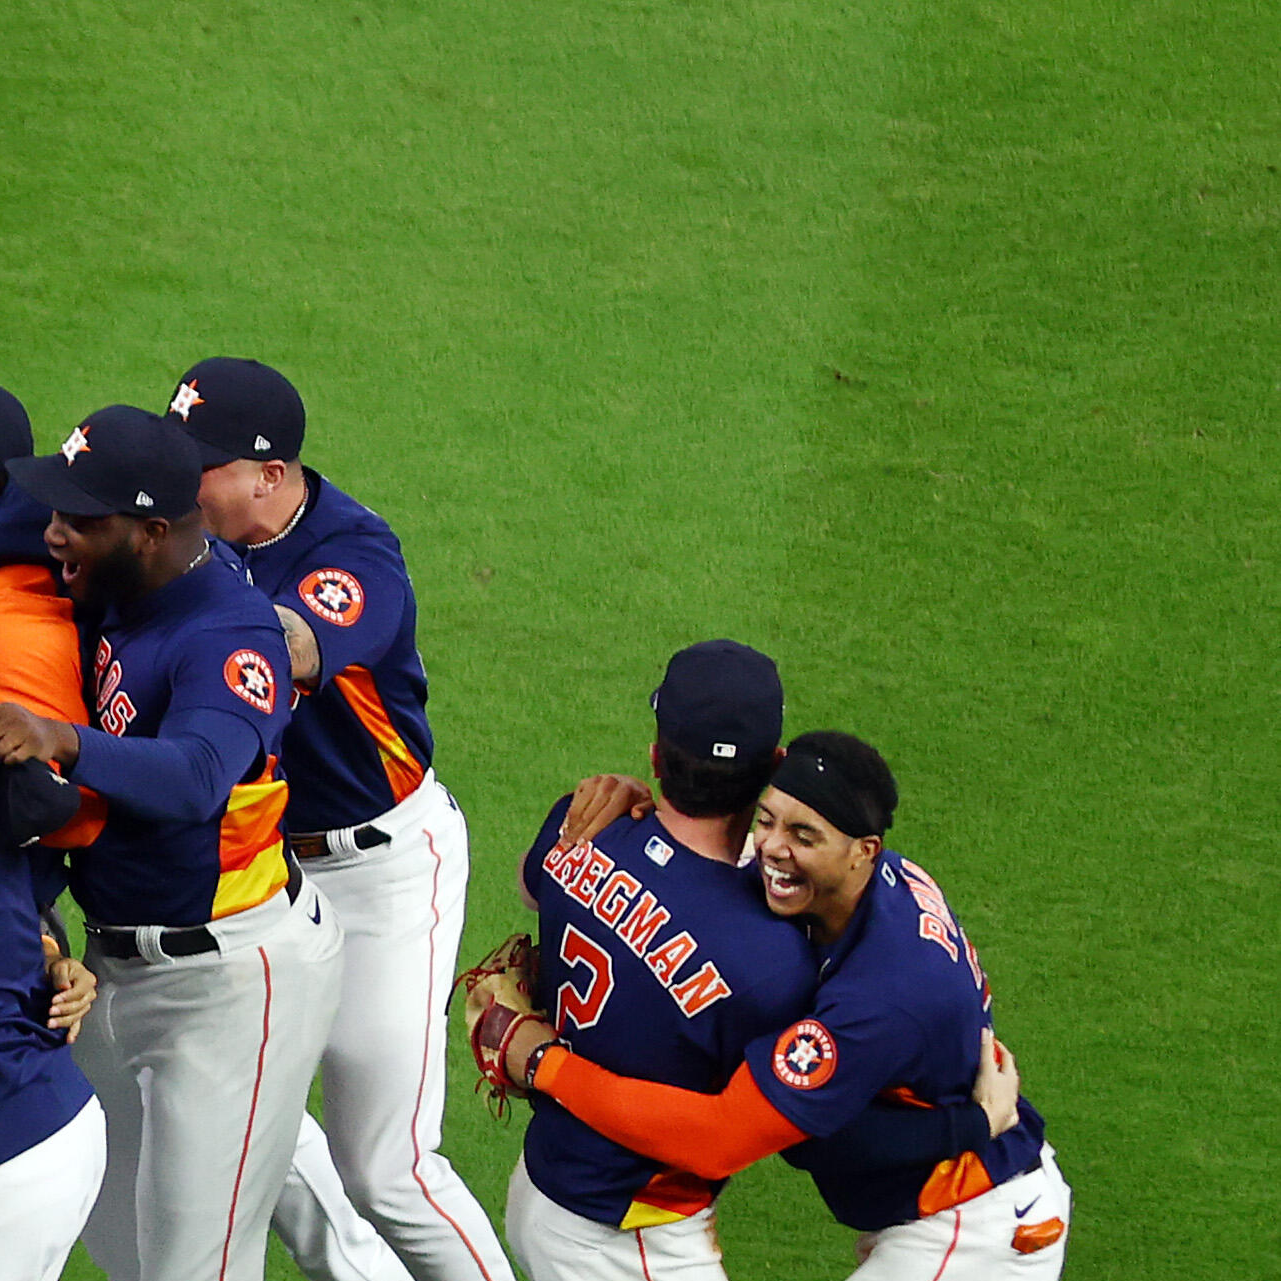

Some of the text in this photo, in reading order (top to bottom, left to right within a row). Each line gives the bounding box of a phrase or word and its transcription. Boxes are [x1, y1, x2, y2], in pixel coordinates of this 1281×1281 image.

[555, 922, 615, 1040] 2
[796, 1023, 834, 1060] HOUSTON
[774, 1053, 810, 1086] ASTROS
